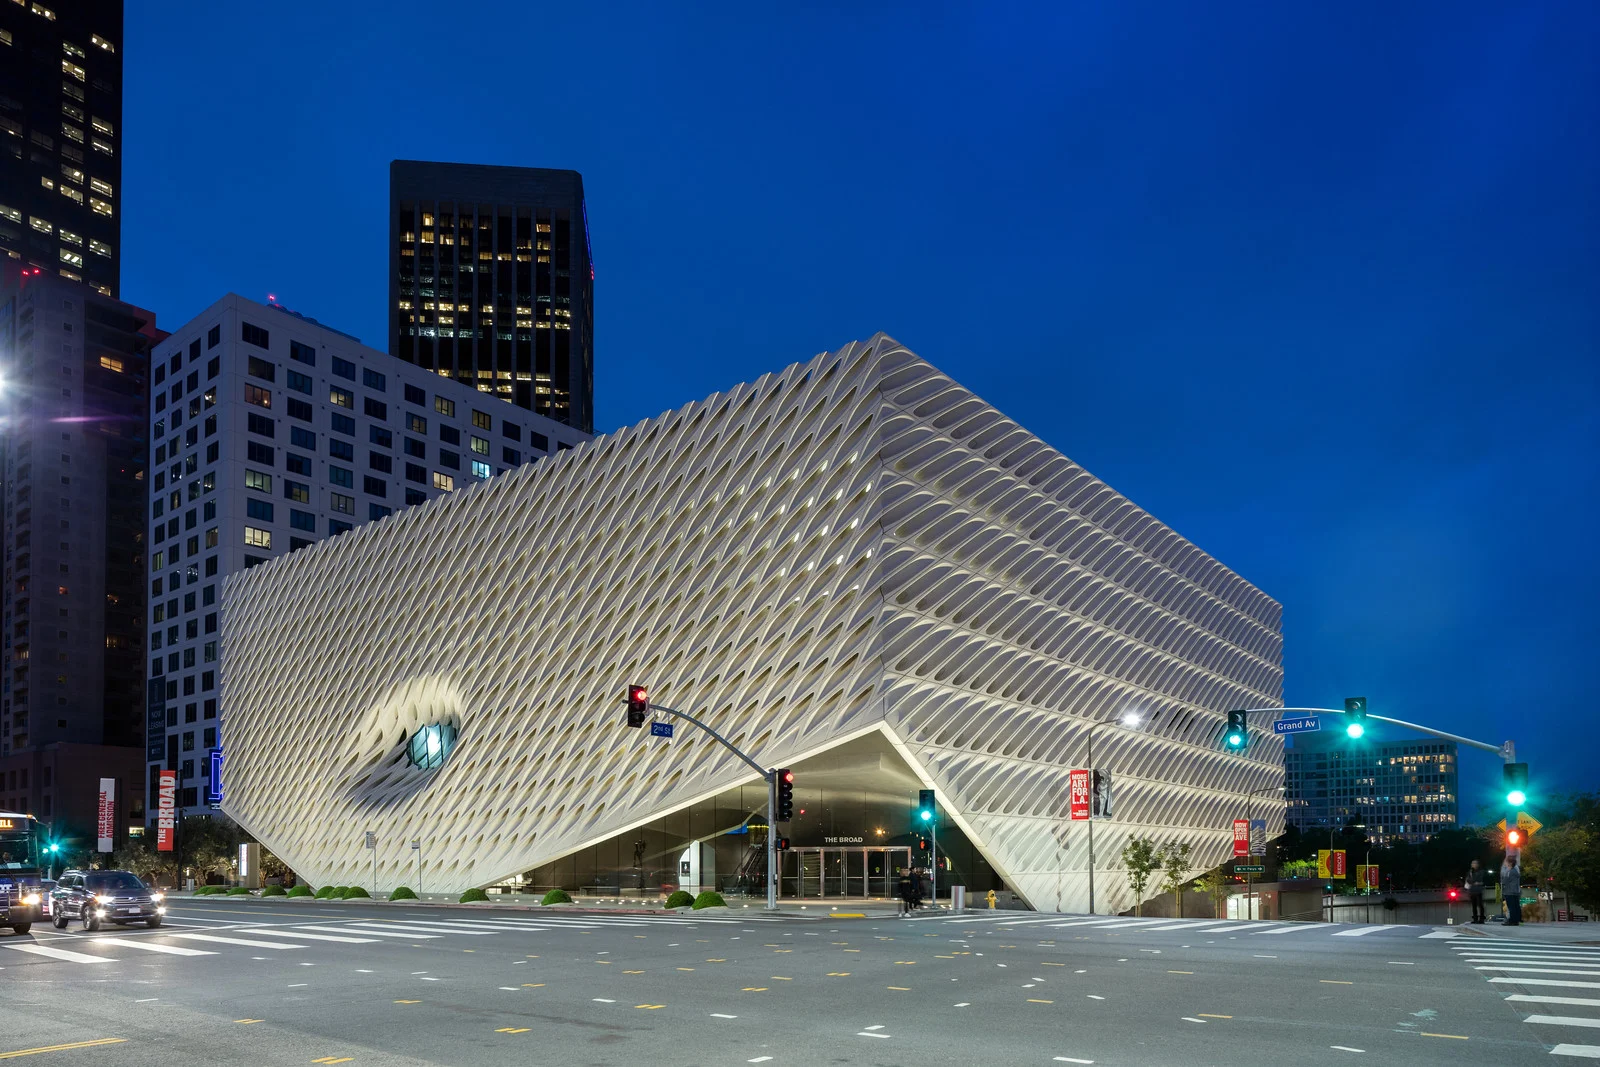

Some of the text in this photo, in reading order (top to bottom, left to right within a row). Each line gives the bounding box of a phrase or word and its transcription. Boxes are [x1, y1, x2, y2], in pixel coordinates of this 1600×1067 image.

[653, 725, 663, 733] 2nd
[1277, 721, 1302, 730] Grand
[1072, 788, 1088, 796] FOR
[1072, 796, 1088, 804] L.A.
[98, 791, 106, 821] GENERAL
[158, 776, 176, 843] THE BROAD
[106, 800, 114, 838] ADMISSION
